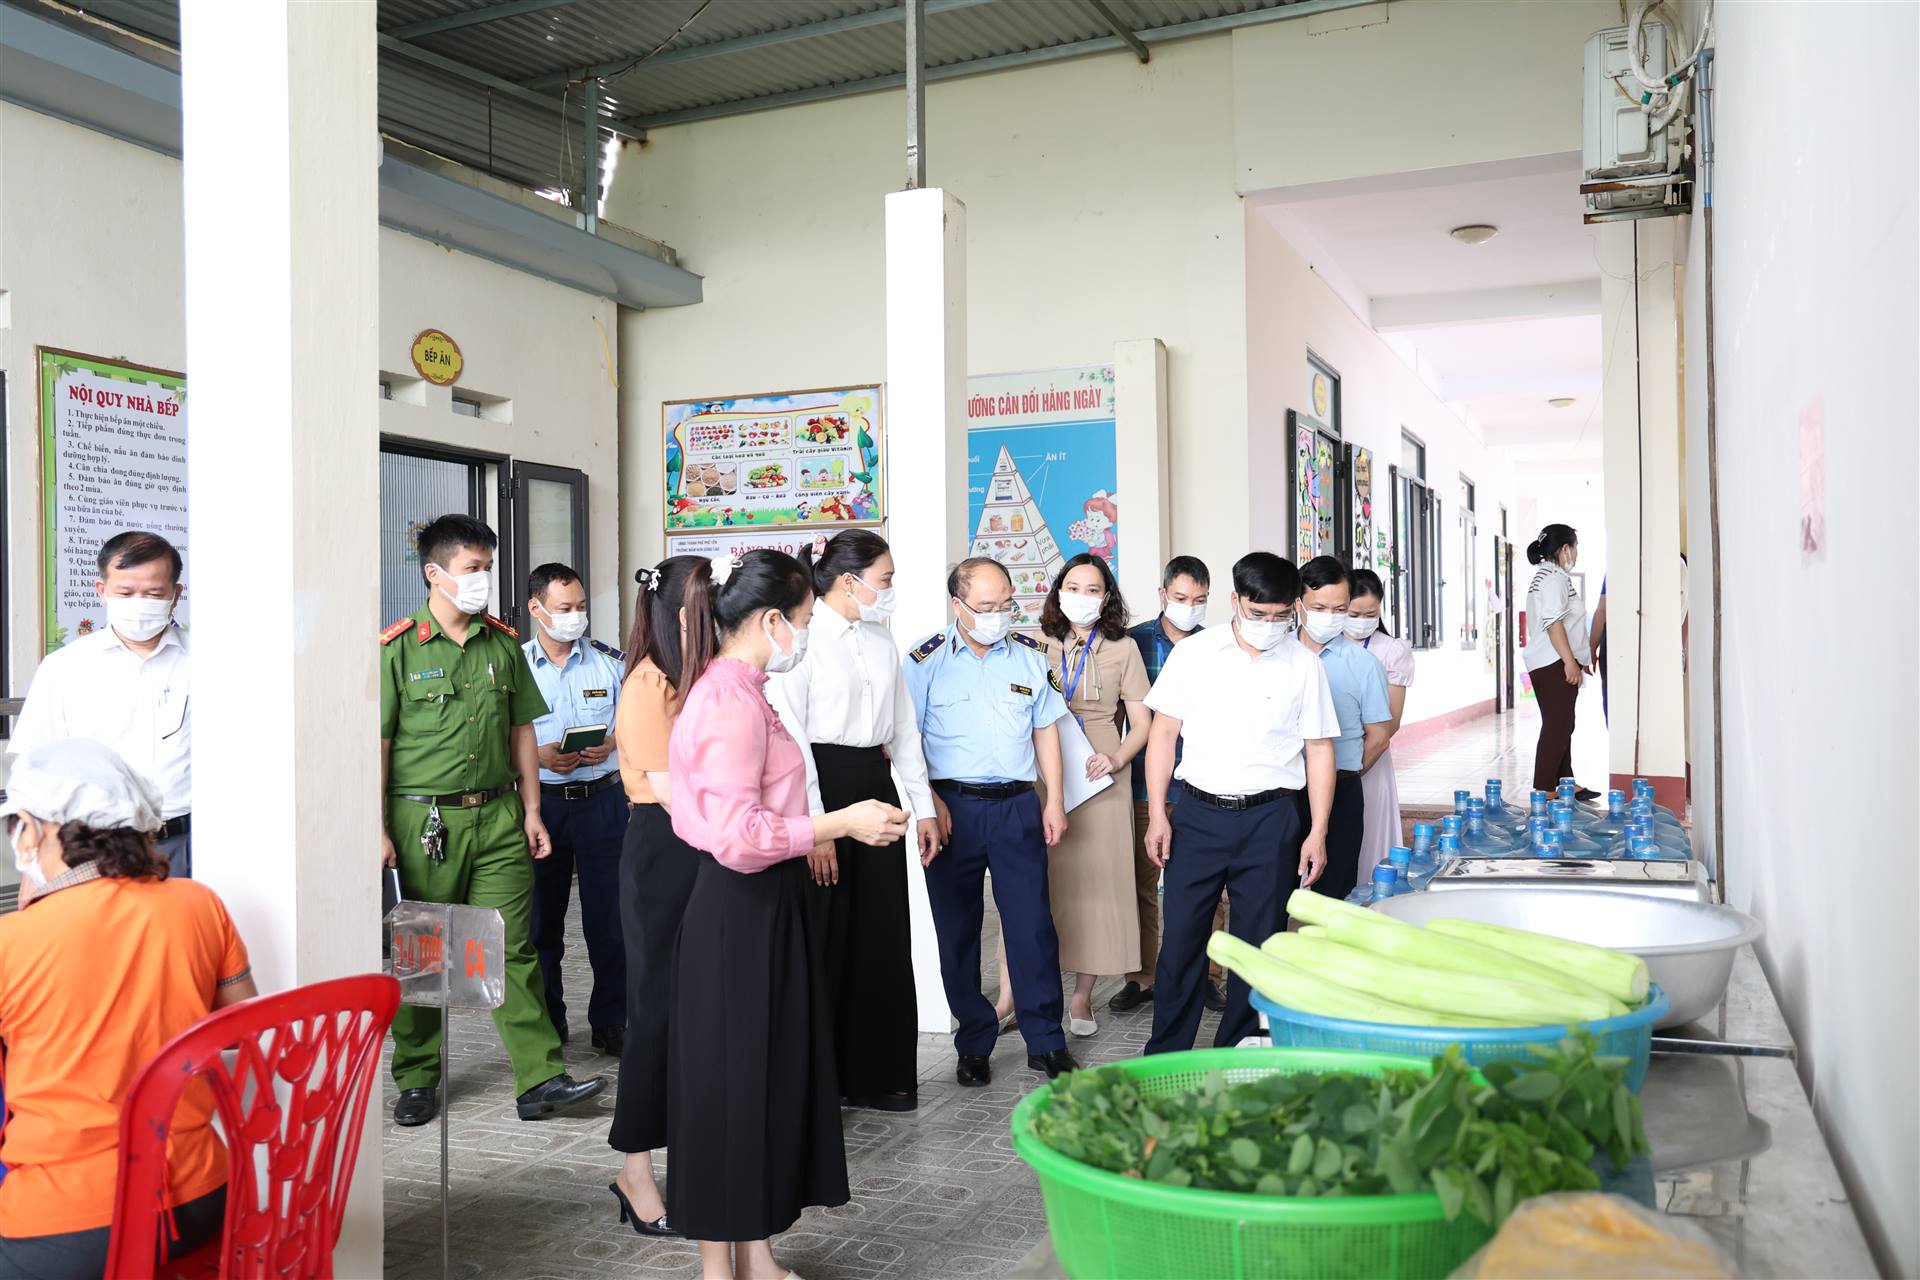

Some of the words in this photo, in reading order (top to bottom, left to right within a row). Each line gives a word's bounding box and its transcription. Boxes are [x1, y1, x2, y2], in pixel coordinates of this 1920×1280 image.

[424, 347, 438, 363] BẾP
[440, 350, 450, 366] ĂN
[69, 384, 92, 406] NỘI
[96, 390, 123, 408] QUY
[127, 395, 153, 413] NHÀ
[157, 396, 179, 417] BẾP
[968, 393, 995, 418] ƯỠNG
[998, 392, 1019, 416] CÂN
[1022, 386, 1039, 414] ĐỐI
[1074, 385, 1101, 410] NGÀY
[75, 410, 93, 421] Thực
[94, 412, 108, 422] hiện
[110, 414, 122, 426] bếp
[132, 418, 146, 428] một
[117, 427, 134, 437] đúng
[137, 430, 151, 440] thực
[68, 440, 74, 449] 3.
[93, 464, 108, 473] chia
[64, 482, 79, 491] theo
[81, 568, 100, 577] Khôn
